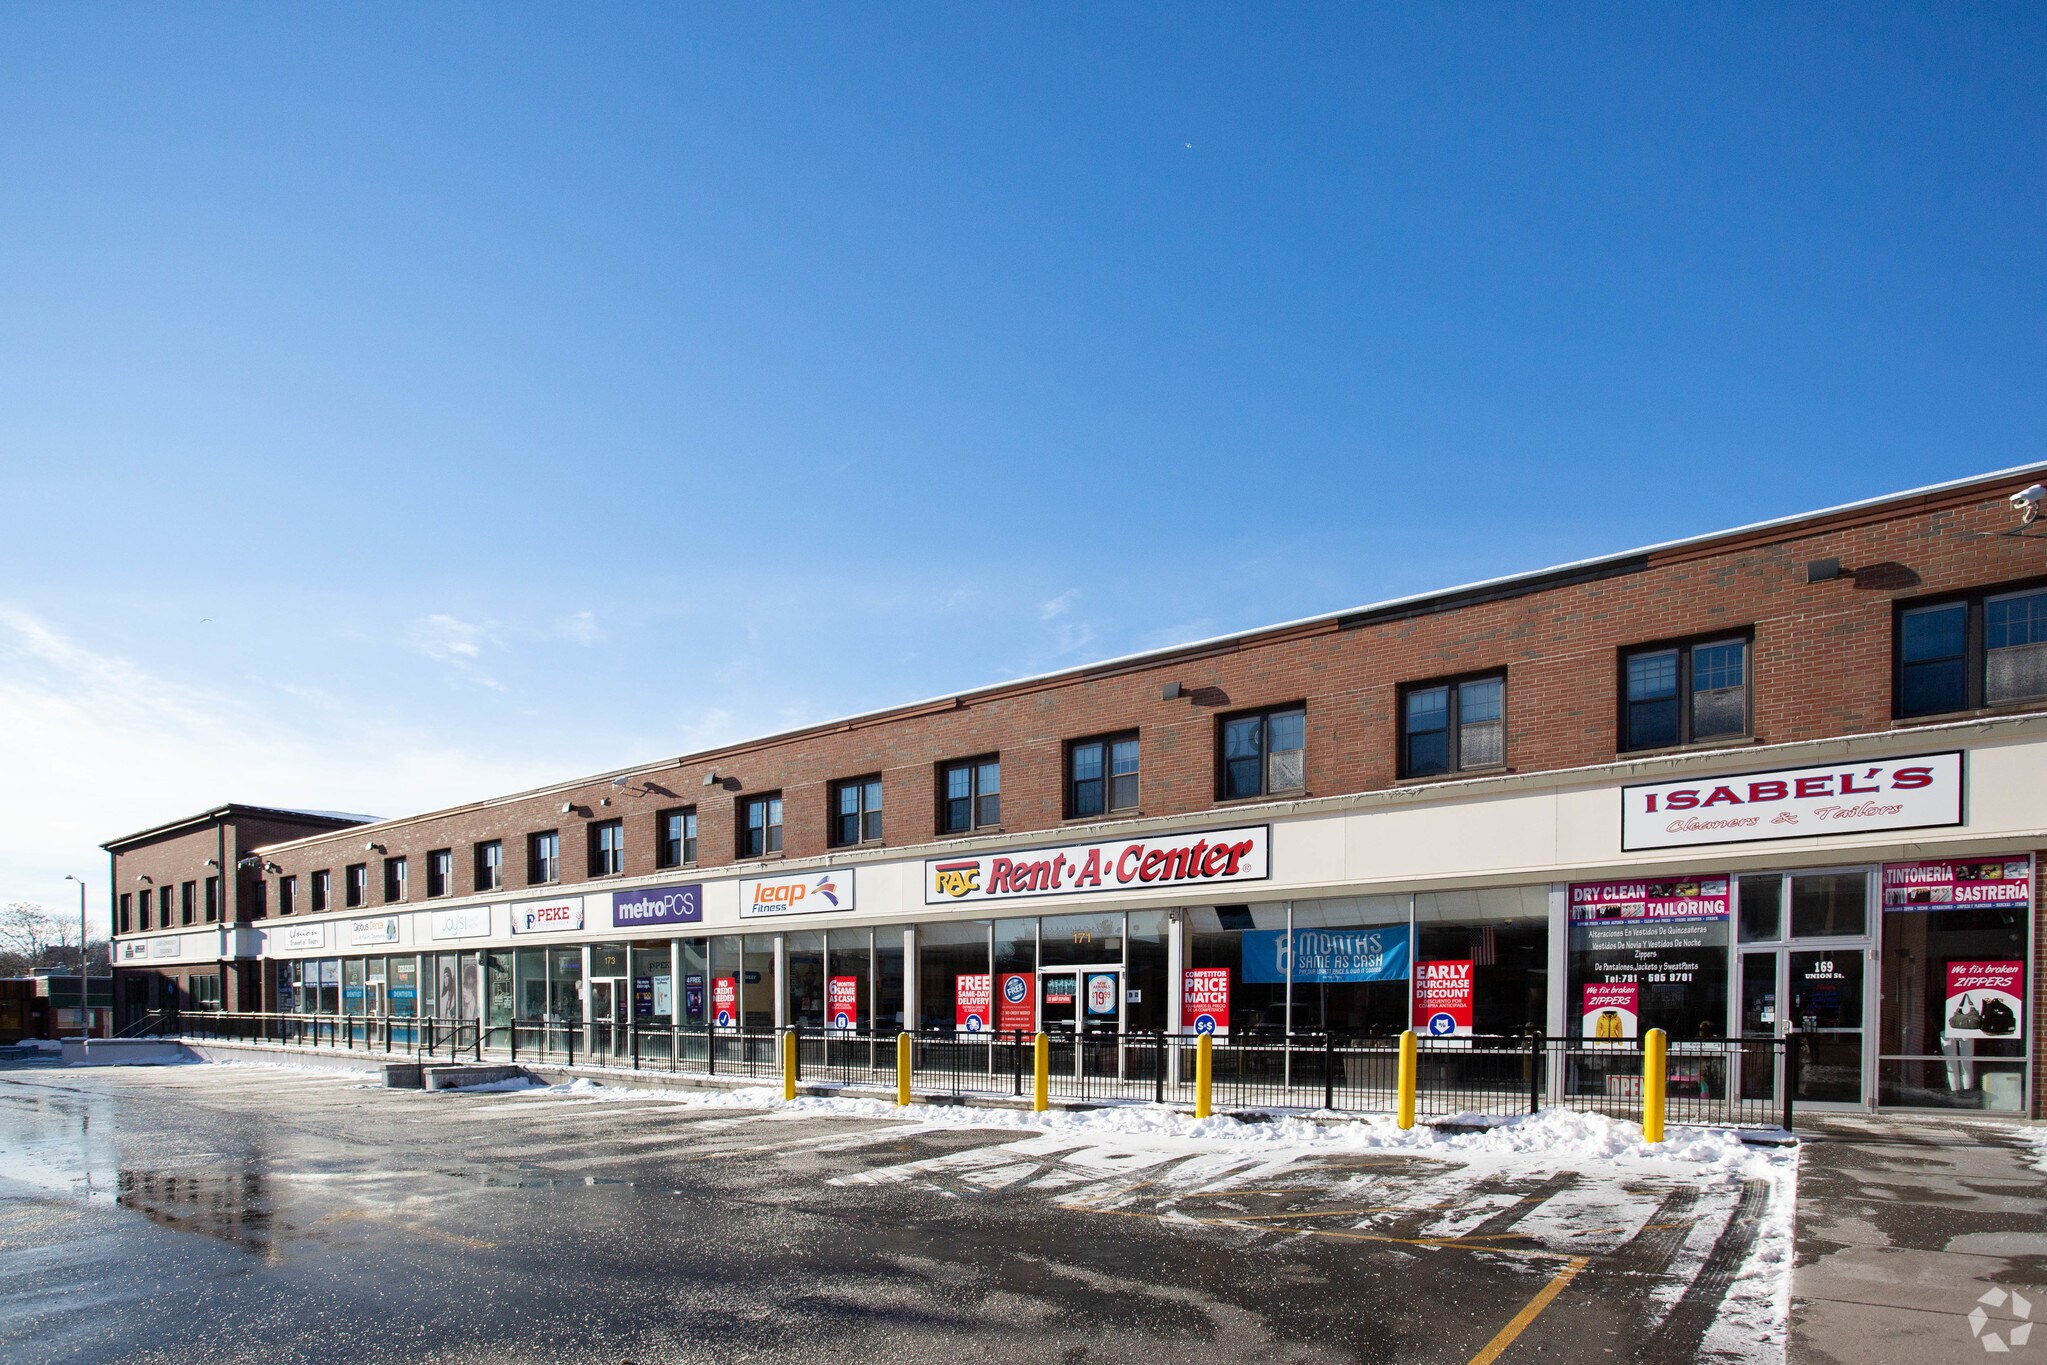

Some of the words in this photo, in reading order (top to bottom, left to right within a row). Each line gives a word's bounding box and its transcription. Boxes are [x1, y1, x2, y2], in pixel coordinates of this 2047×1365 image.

[1644, 766, 1935, 814] ISABEL'S
[1665, 814, 1760, 834] Cleaners
[1771, 811, 1799, 825] &
[1812, 800, 1904, 821] Tailors
[1886, 862, 1954, 884] TINTONERÍA
[935, 867, 980, 897] RAC
[753, 882, 807, 907] leap
[1573, 887, 1600, 902] DRY
[1603, 884, 1646, 900] CLEAN
[1954, 880, 2029, 902] SASTRERÍA
[618, 892, 694, 920] metroPCS
[752, 903, 787, 913] Fitness
[1647, 900, 1725, 916] TAILORING
[537, 906, 570, 922] PEKE
[289, 929, 317, 939] Union
[1073, 932, 1091, 943] 171
[1588, 929, 1624, 939] Alteraciones
[1625, 928, 1632, 936] En
[1632, 927, 1658, 936] Vestidos
[1659, 926, 1667, 935] De
[1667, 925, 1707, 935] Quinceañeras
[1300, 931, 1383, 955] MONTHS
[1592, 941, 1617, 950] Vestidos
[1617, 941, 1625, 949] De
[1626, 941, 1642, 949] Novia
[1642, 940, 1648, 948] Y
[1648, 939, 1673, 948] Vestidos
[1674, 938, 1682, 947] De
[1683, 938, 1702, 947] Noche
[605, 957, 616, 965] 173
[1299, 955, 1330, 969] SAME
[1334, 954, 1349, 968] AS
[1353, 953, 1384, 968] CASH
[1634, 949, 1657, 961] Zippers
[1416, 964, 1470, 980] EARLY
[1594, 963, 1603, 971] De
[1814, 961, 1834, 973] 169
[1951, 965, 1966, 974] We
[1968, 965, 1984, 974] fix
[1985, 964, 2019, 974] broken
[1185, 970, 1227, 978] COMPETITOR
[829, 980, 837, 995] 6
[957, 976, 990, 990] FREE
[1185, 978, 1227, 992] PRICE
[1416, 979, 1470, 989] PURCHASE
[1953, 976, 2013, 987] ZIPPERS
[714, 987, 733, 995] CREDIT
[1006, 983, 1024, 997] FREE
[1416, 989, 1470, 999] DISCOUNT
[1586, 986, 1598, 994] We
[1599, 986, 1610, 994] fix
[1610, 985, 1635, 994] broken
[713, 994, 734, 1002] NEEDED
[838, 995, 855, 1003] CASH
[1185, 992, 1227, 1003] MATCH
[1588, 996, 1631, 1006] ZIPPERS
